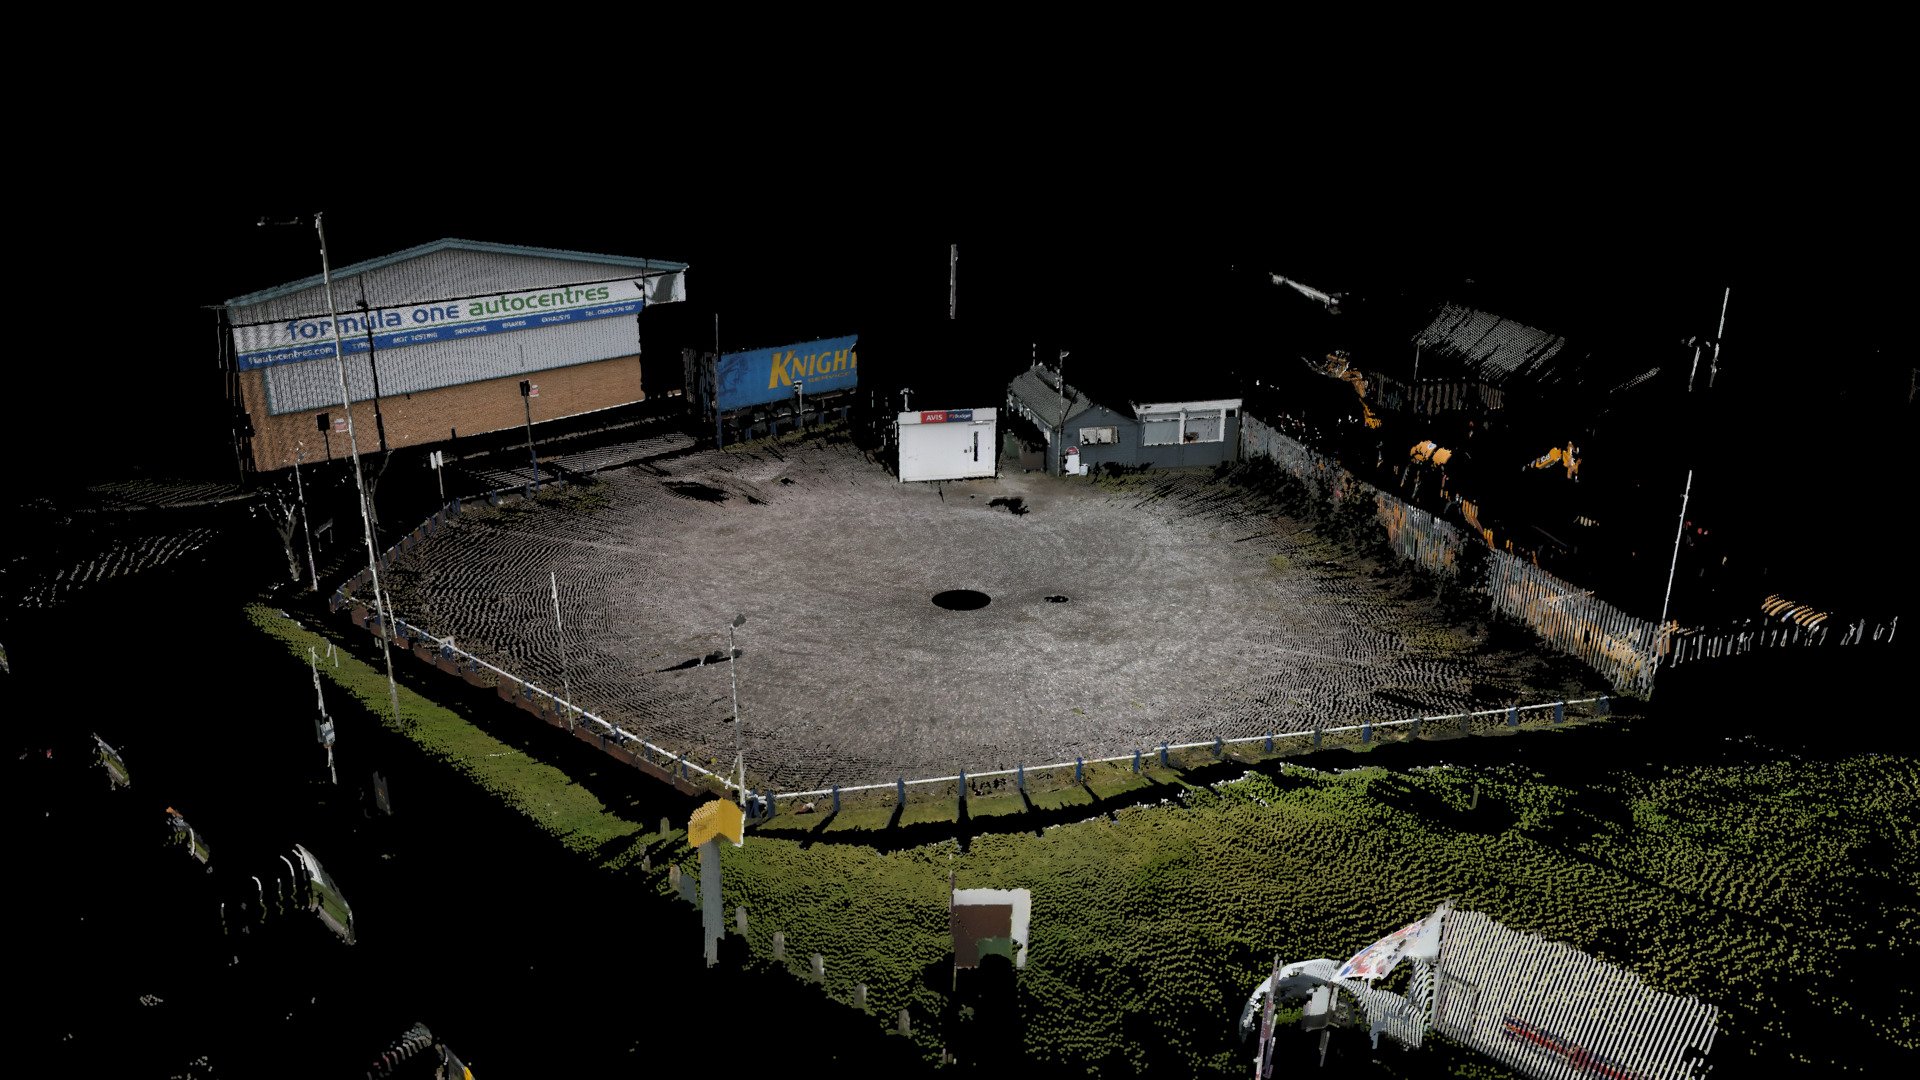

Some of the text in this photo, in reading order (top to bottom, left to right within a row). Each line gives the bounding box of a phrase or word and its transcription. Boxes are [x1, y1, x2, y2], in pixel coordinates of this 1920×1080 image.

[286, 286, 610, 341] formula one autocentres
[502, 320, 526, 329] BRAKES
[926, 413, 943, 421] AVIS
